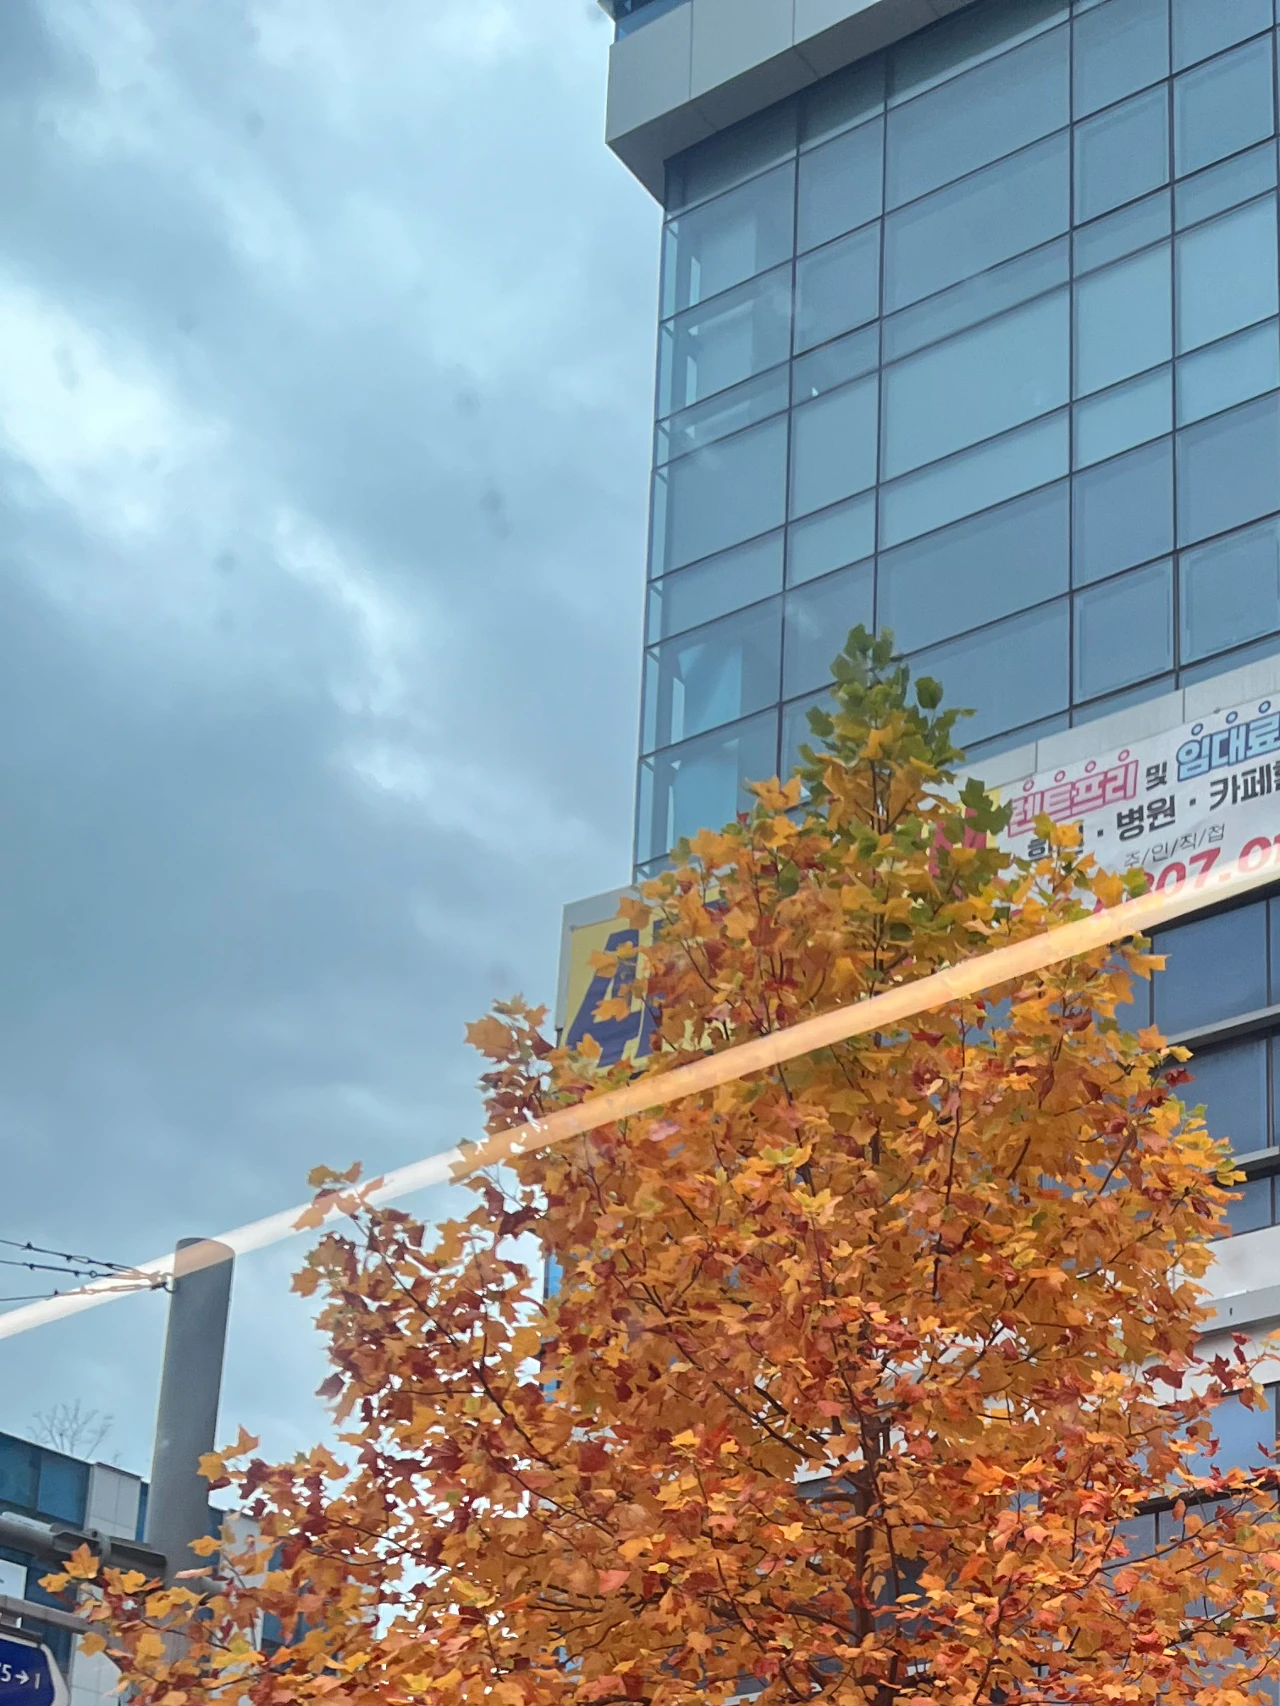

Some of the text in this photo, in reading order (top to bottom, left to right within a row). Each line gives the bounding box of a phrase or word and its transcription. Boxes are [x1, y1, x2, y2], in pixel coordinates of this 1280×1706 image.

[1007, 756, 1140, 839] 렌트프리
[1145, 762, 1168, 793] 및
[1116, 795, 1176, 843] 병원
